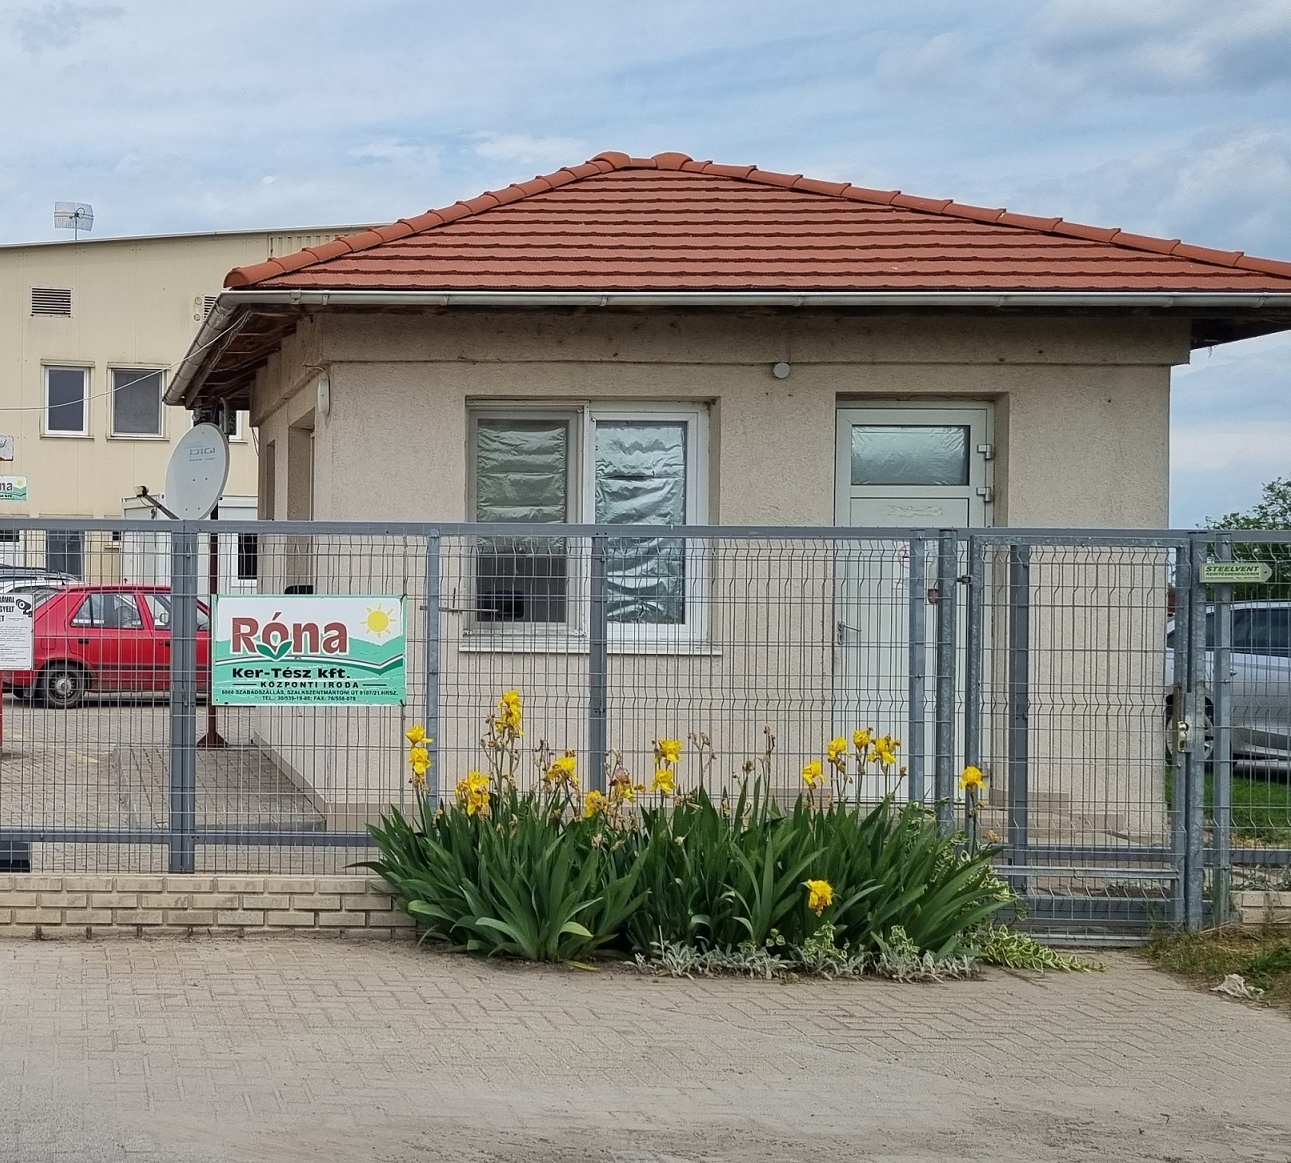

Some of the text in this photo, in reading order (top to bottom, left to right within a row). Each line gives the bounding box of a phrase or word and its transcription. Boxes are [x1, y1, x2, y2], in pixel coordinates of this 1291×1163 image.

[189, 447, 216, 456] DIGI
[231, 611, 348, 654] Róna
[232, 667, 351, 678] Ker-Tész kft.
[260, 680, 318, 688] KÖZPONTI
